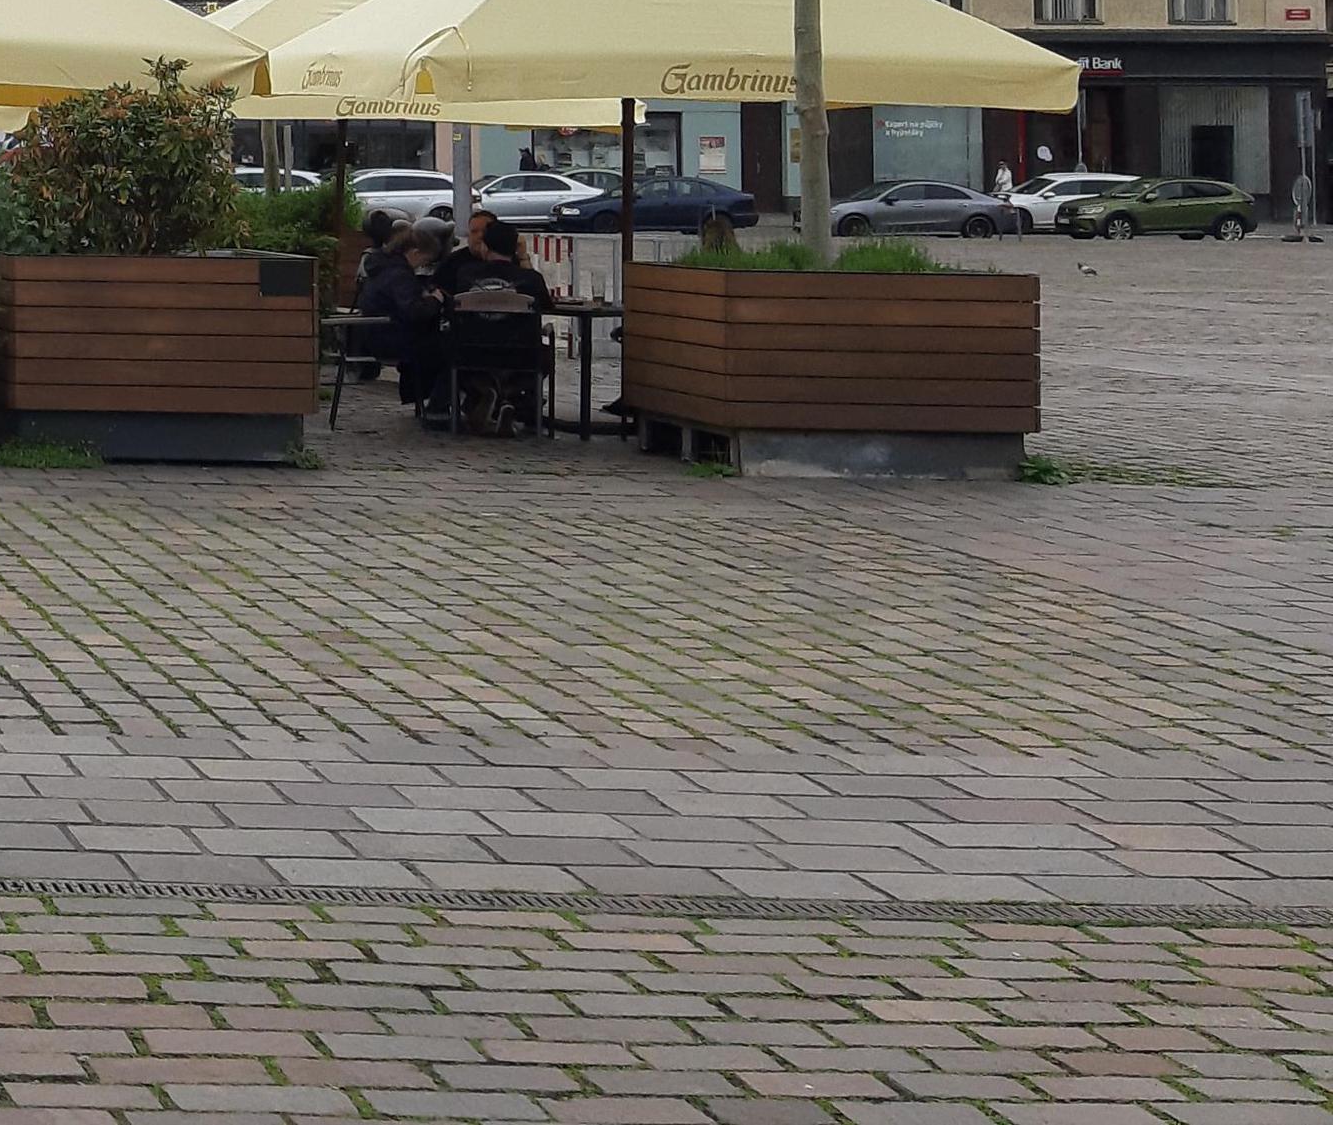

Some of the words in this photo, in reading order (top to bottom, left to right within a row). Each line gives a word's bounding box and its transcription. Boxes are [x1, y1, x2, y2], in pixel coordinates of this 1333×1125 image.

[1092, 57, 1122, 69] Bank
[661, 63, 797, 94] Gambrinus
[336, 96, 441, 117] Gambrinus
